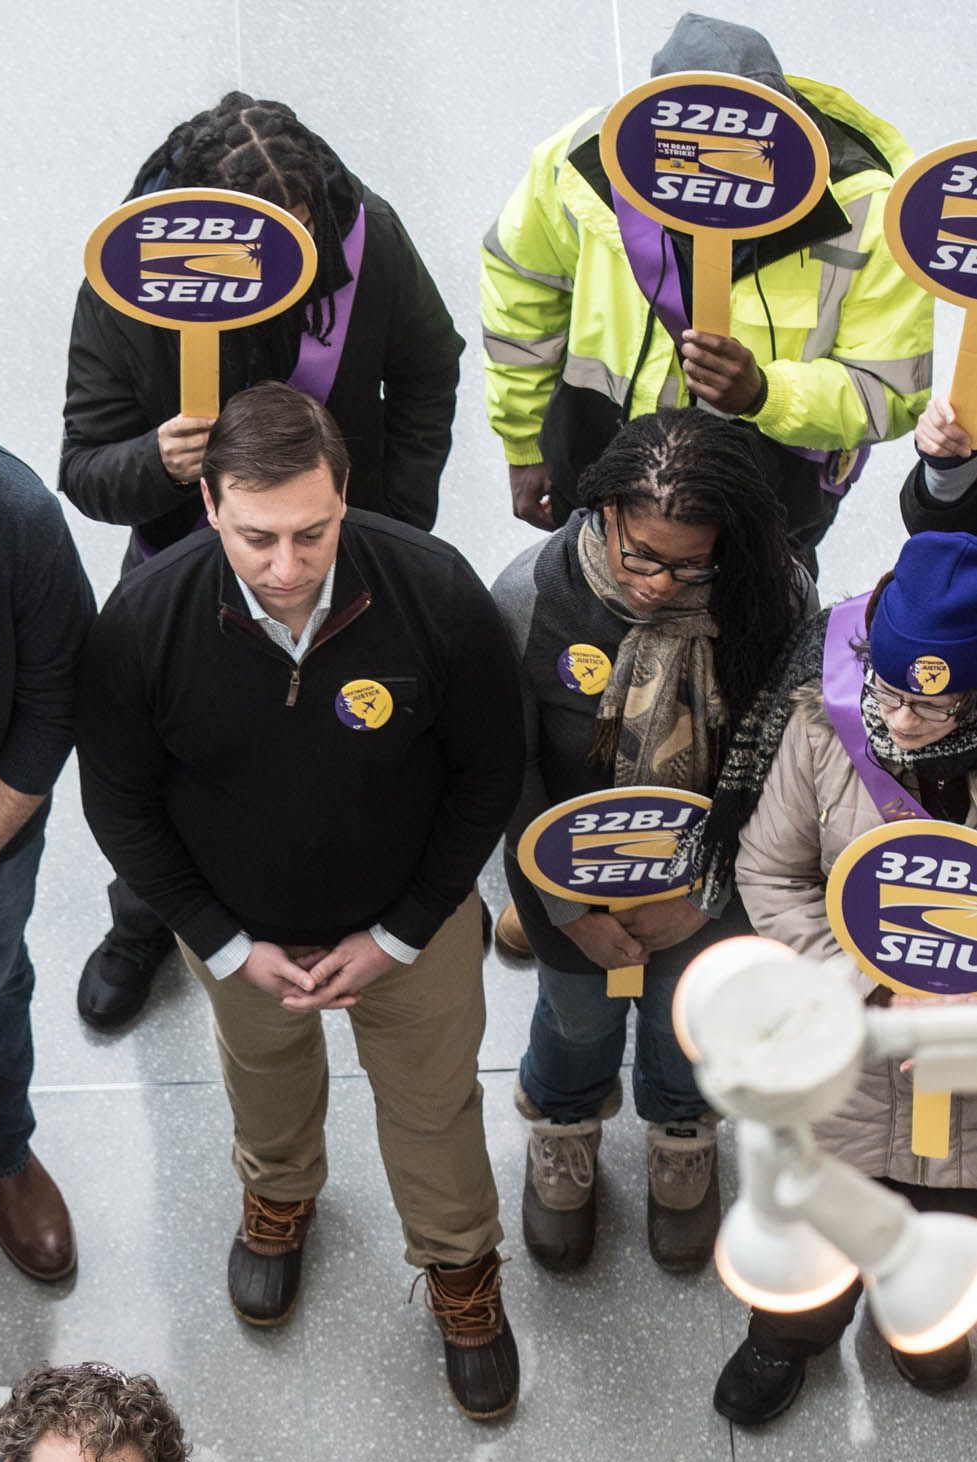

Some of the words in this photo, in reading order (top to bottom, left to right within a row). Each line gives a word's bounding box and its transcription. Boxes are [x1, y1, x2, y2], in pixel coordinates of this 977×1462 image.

[651, 101, 778, 137] 32BJ
[664, 149, 695, 157] STRIKE!
[670, 143, 696, 151] READY
[652, 176, 775, 209] SEIU
[941, 165, 977, 196] 3
[136, 217, 265, 241] 32BJ
[138, 281, 263, 303] SEIU
[568, 807, 693, 833] 32BJ
[568, 861, 689, 885] SEIU
[875, 851, 977, 892] 32B
